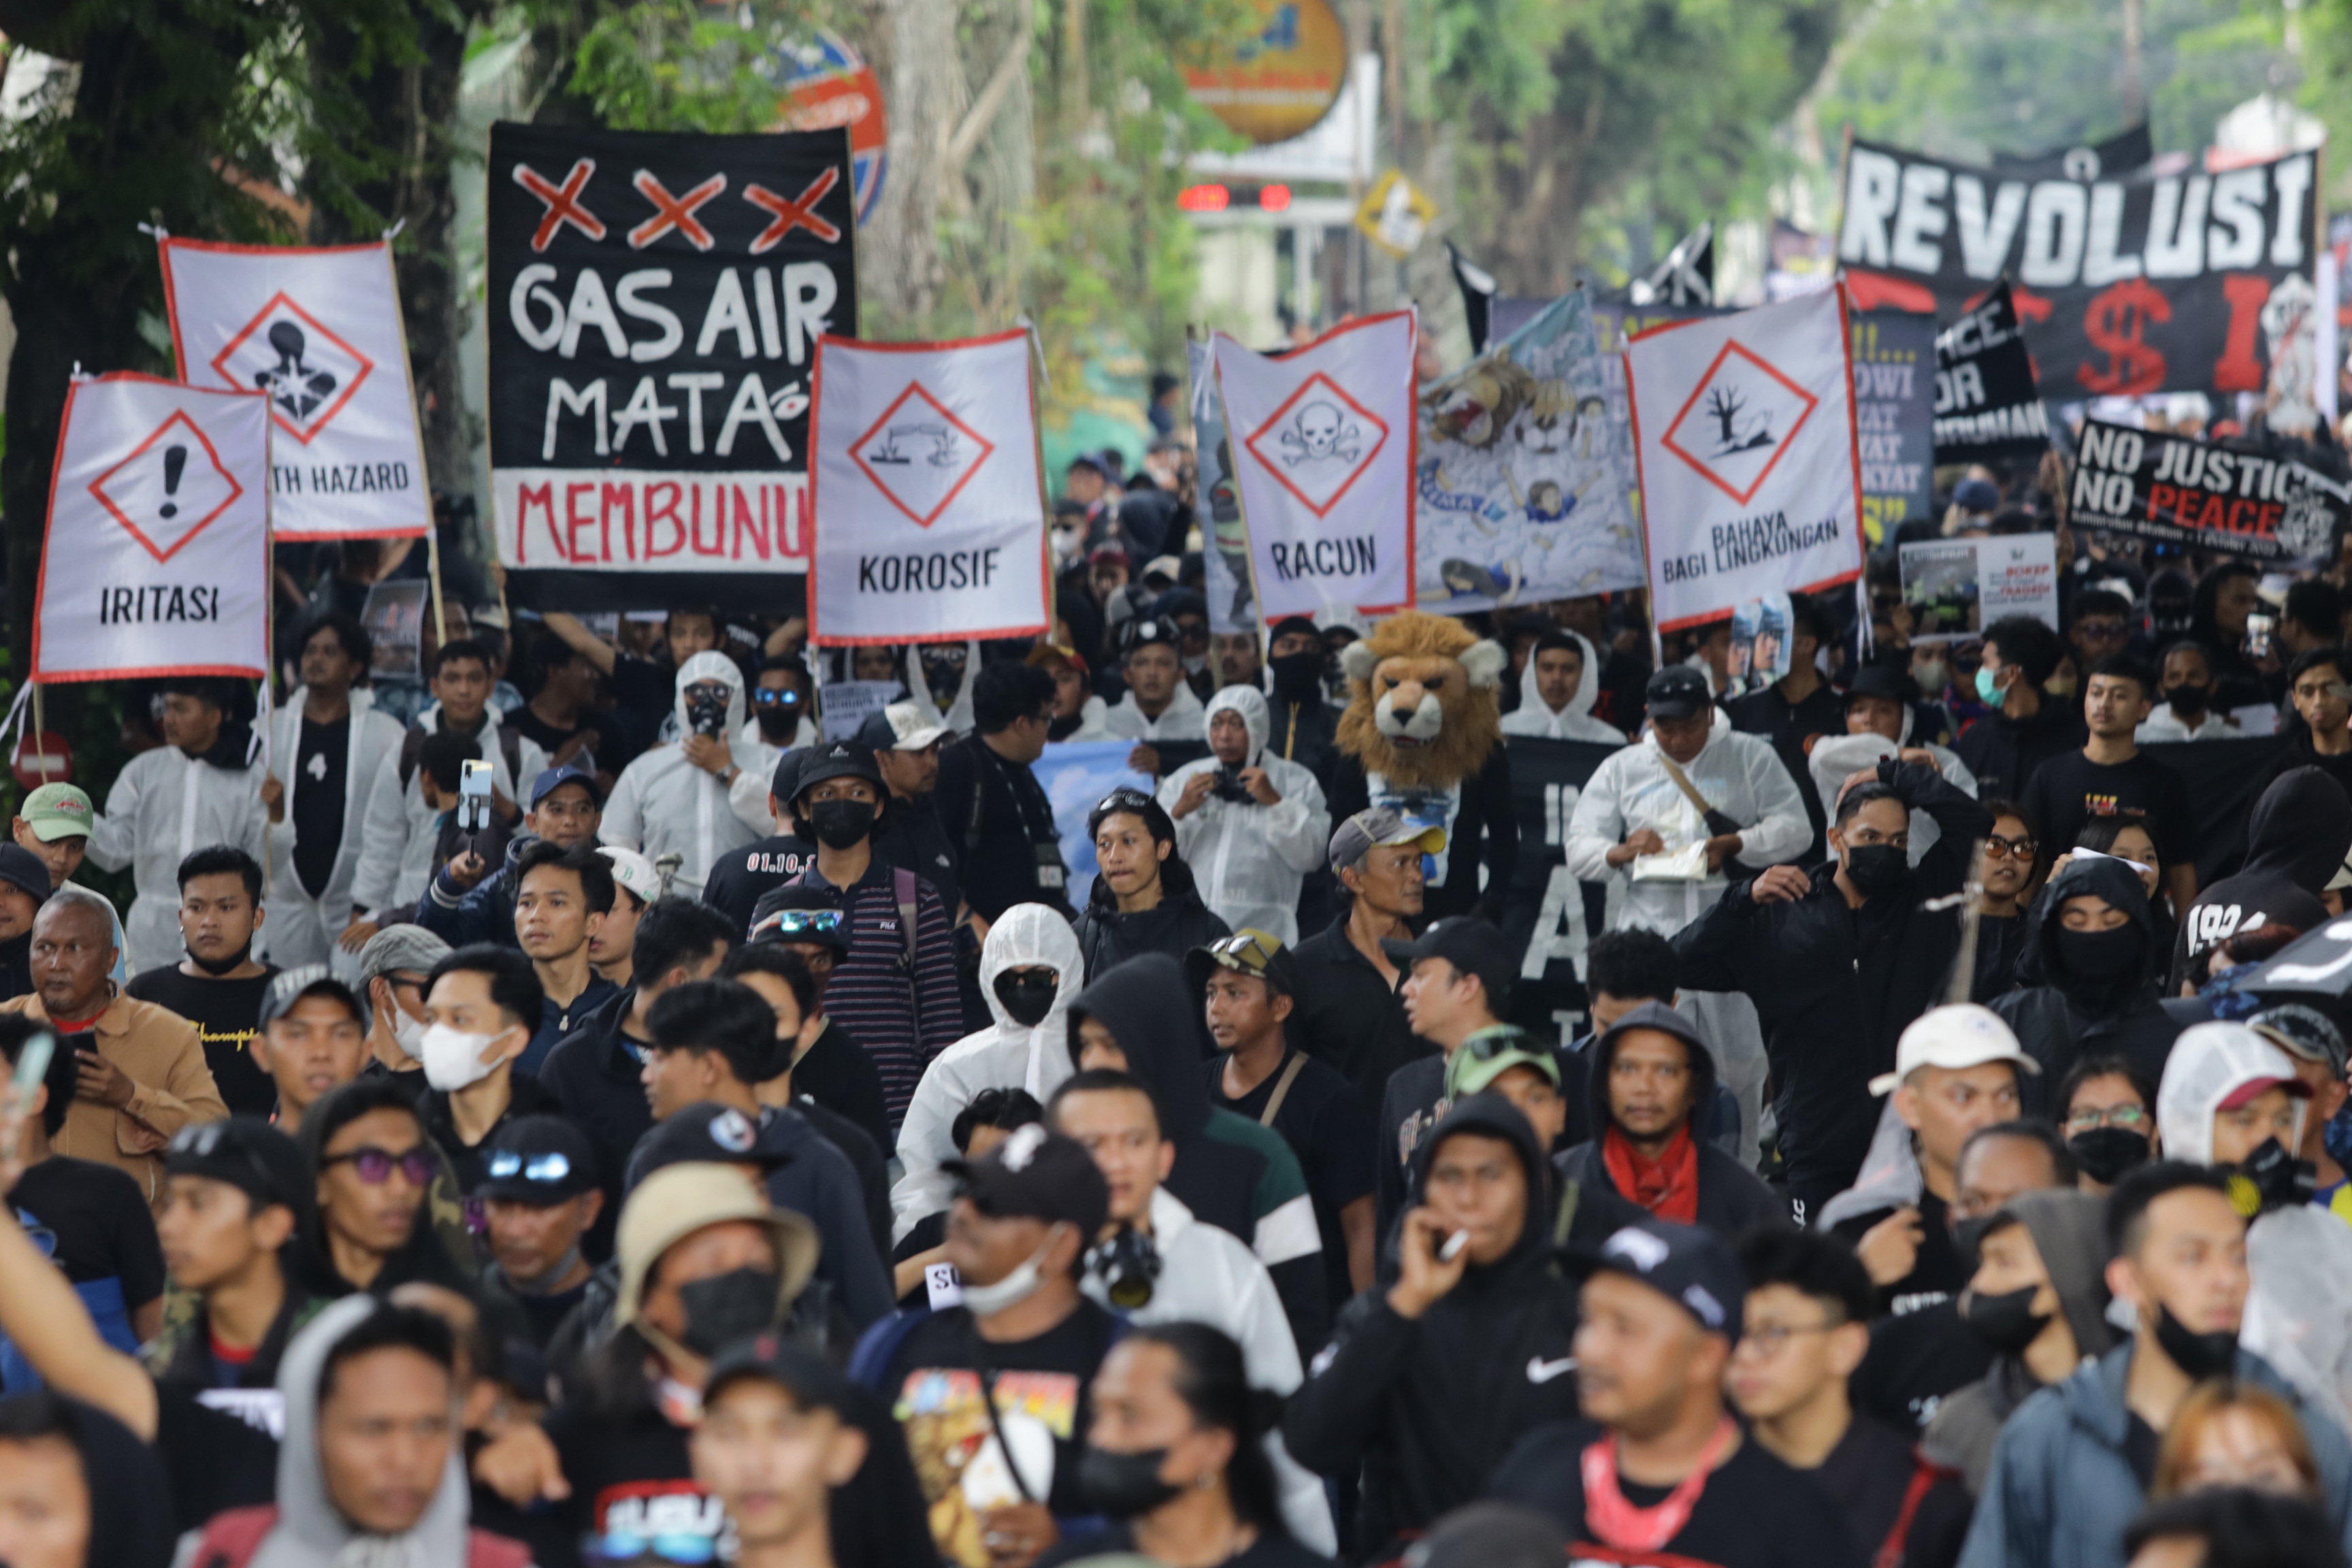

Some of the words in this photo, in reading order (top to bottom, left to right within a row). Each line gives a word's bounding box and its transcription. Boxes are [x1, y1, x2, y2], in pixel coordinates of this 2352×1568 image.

[1839, 146, 2313, 288] REVOLUSI
[509, 263, 684, 363] GAS
[696, 261, 838, 366] AIR
[542, 372, 794, 463] MATA
[2080, 423, 2145, 476] NO
[311, 462, 410, 494] HAZARD
[2072, 467, 2136, 517] NO
[2145, 482, 2284, 542] PEACE
[1663, 553, 1708, 585] BAGI
[1714, 517, 1840, 574] LINGKUNGAN
[1711, 510, 1788, 550] BAHAYA
[858, 546, 1001, 593] KOROSIF
[1271, 534, 1377, 581] RACUN
[99, 585, 220, 625] IRITASI
